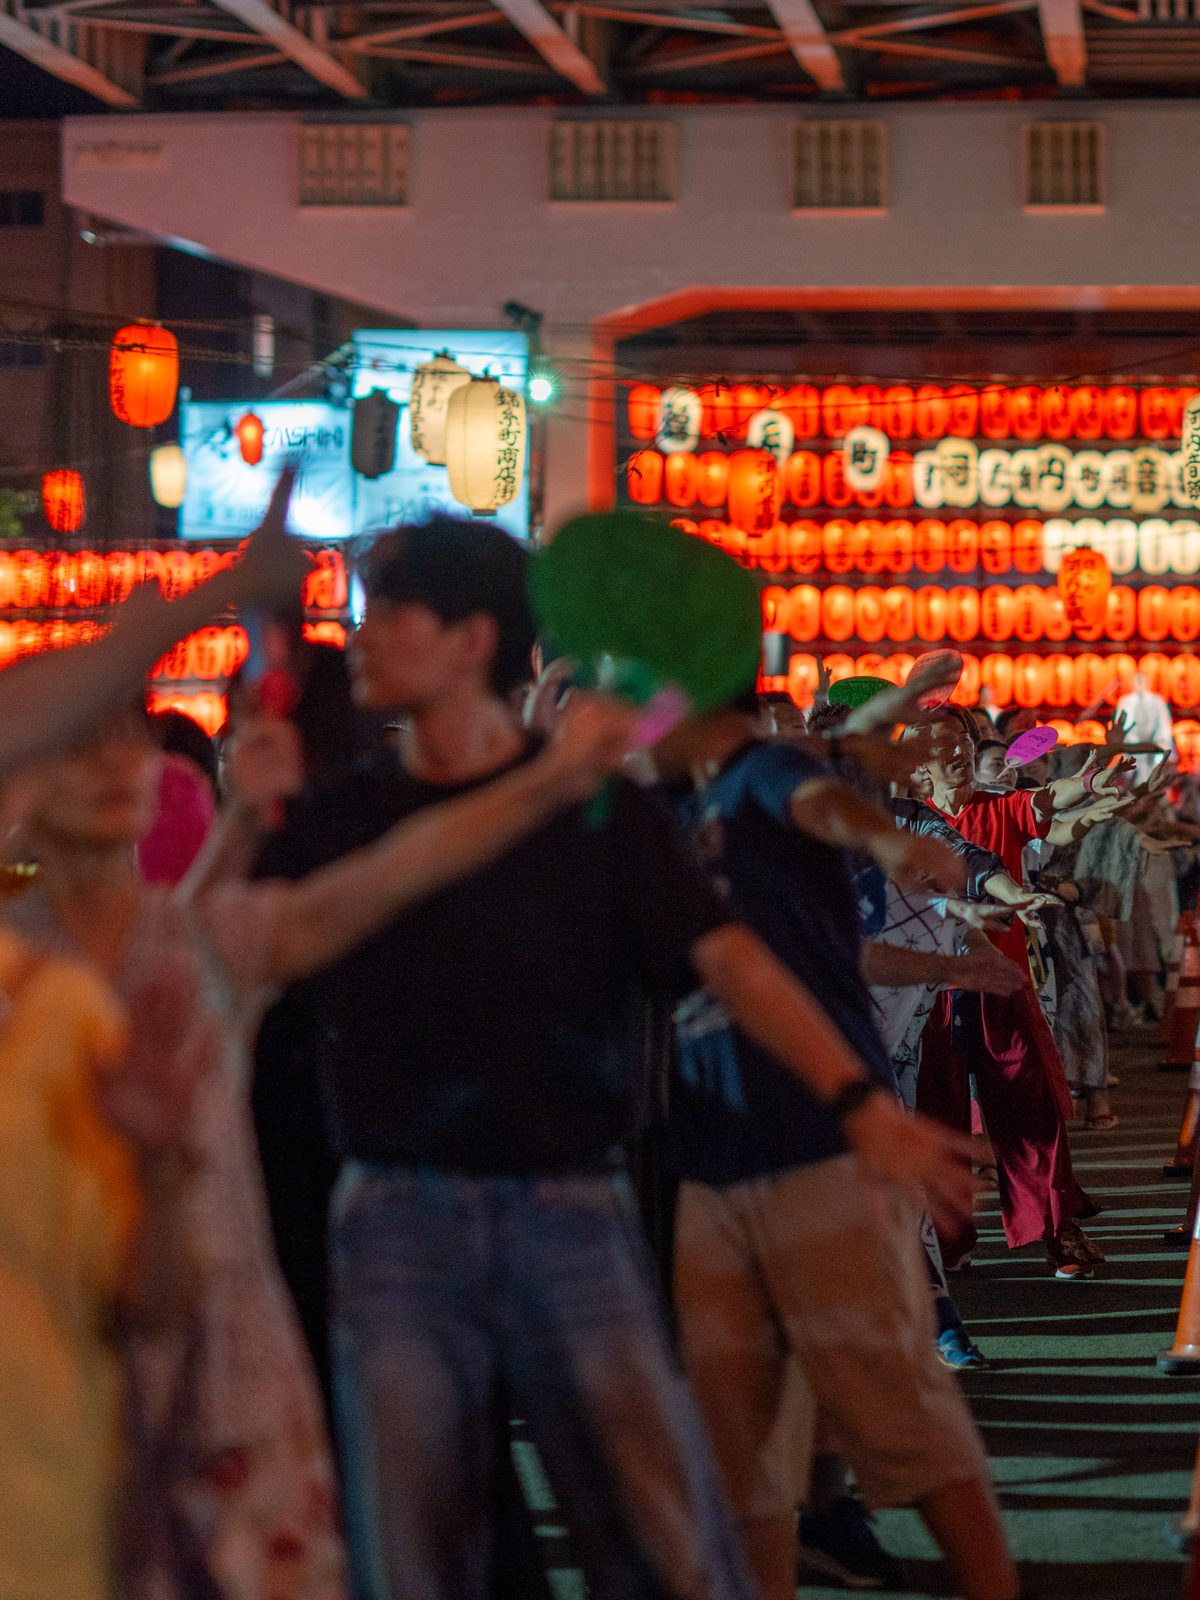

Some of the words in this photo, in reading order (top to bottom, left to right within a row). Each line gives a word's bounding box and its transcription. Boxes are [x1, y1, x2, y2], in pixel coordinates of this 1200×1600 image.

[494, 389, 520, 503] 錦糸町商店街
[851, 441, 877, 475] 町
